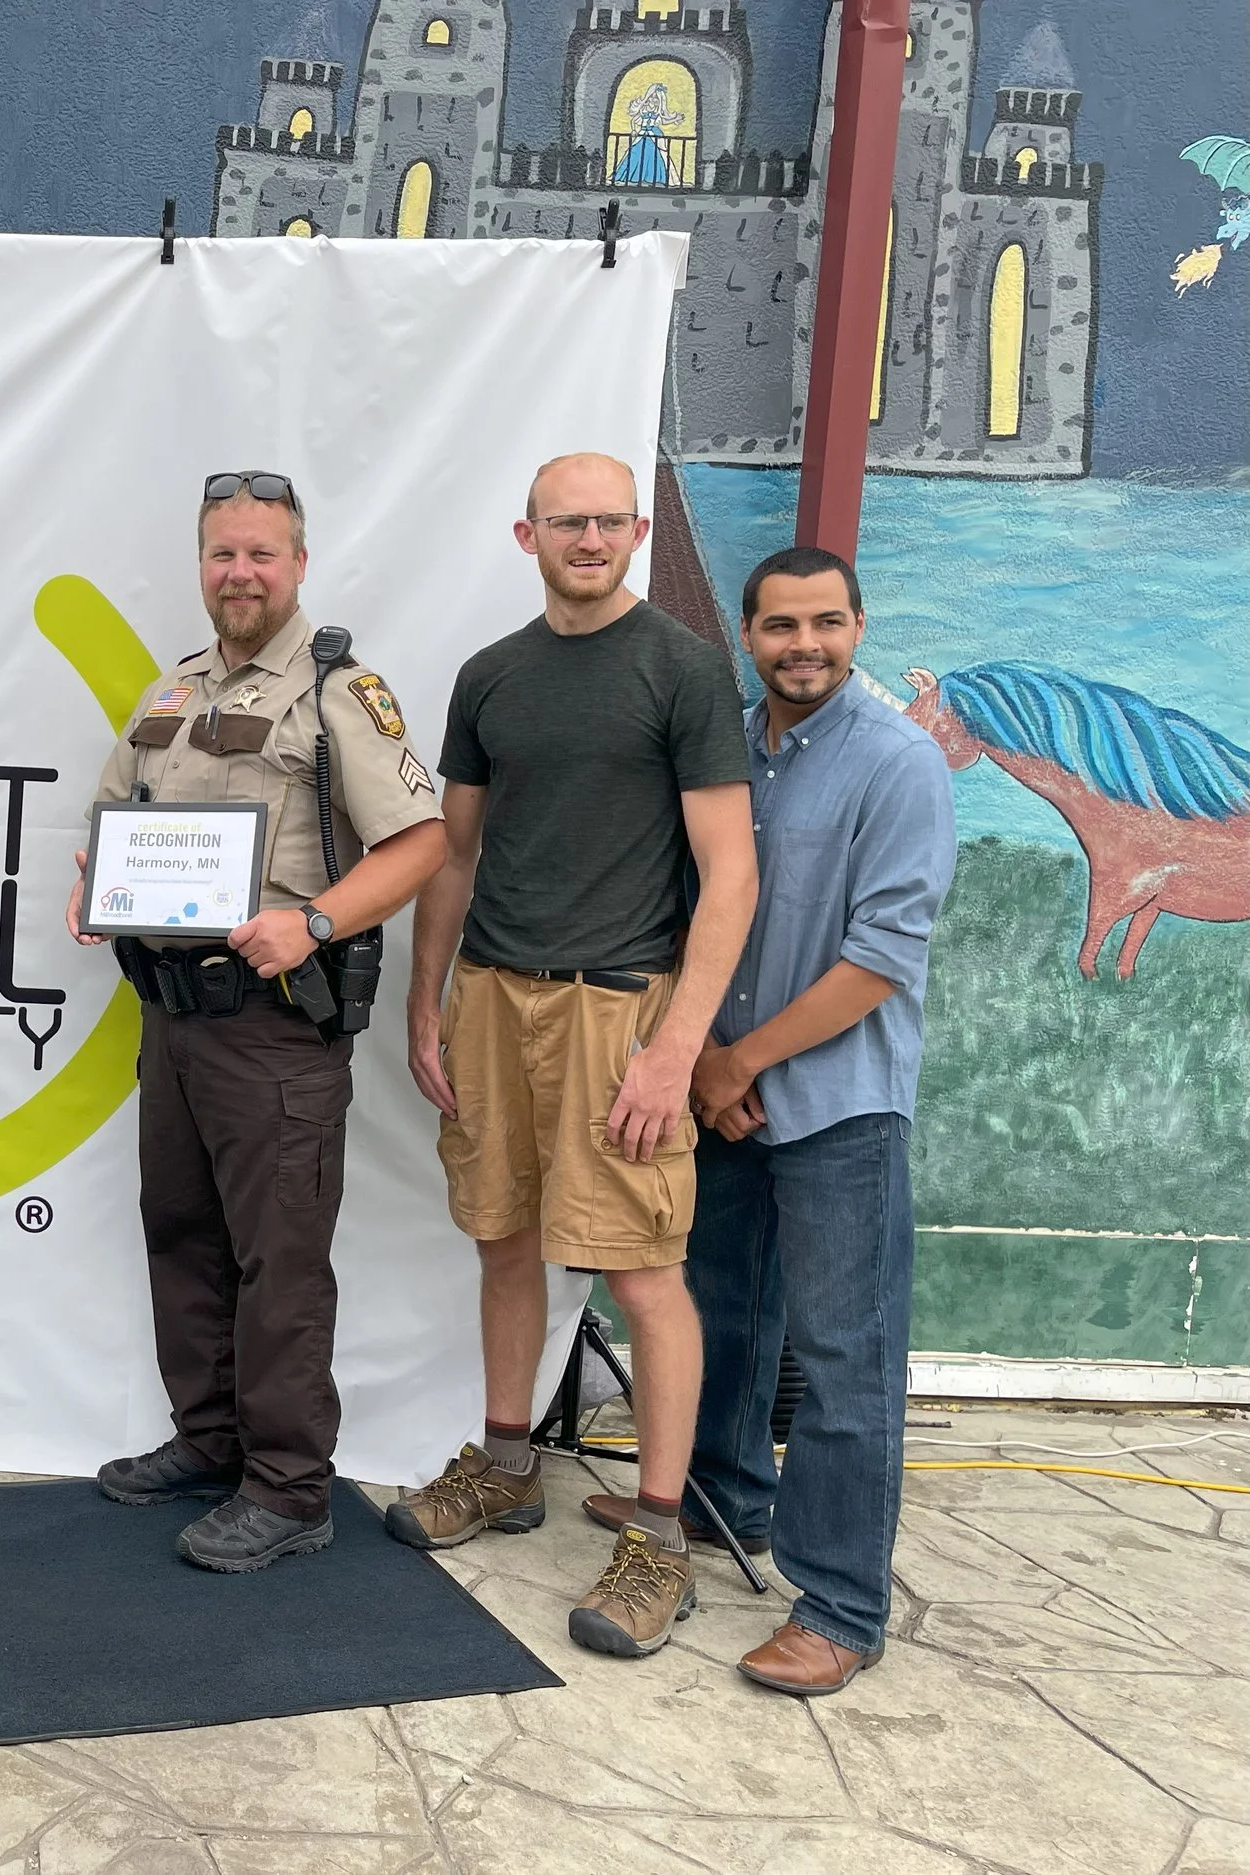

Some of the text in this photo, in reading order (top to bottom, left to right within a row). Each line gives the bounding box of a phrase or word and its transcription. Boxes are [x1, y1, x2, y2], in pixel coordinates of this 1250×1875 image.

[137, 822, 203, 833] certificate of
[129, 832, 222, 849] RECOGNITION
[126, 855, 220, 872] Harmony, MN
[109, 892, 135, 912] Mi
